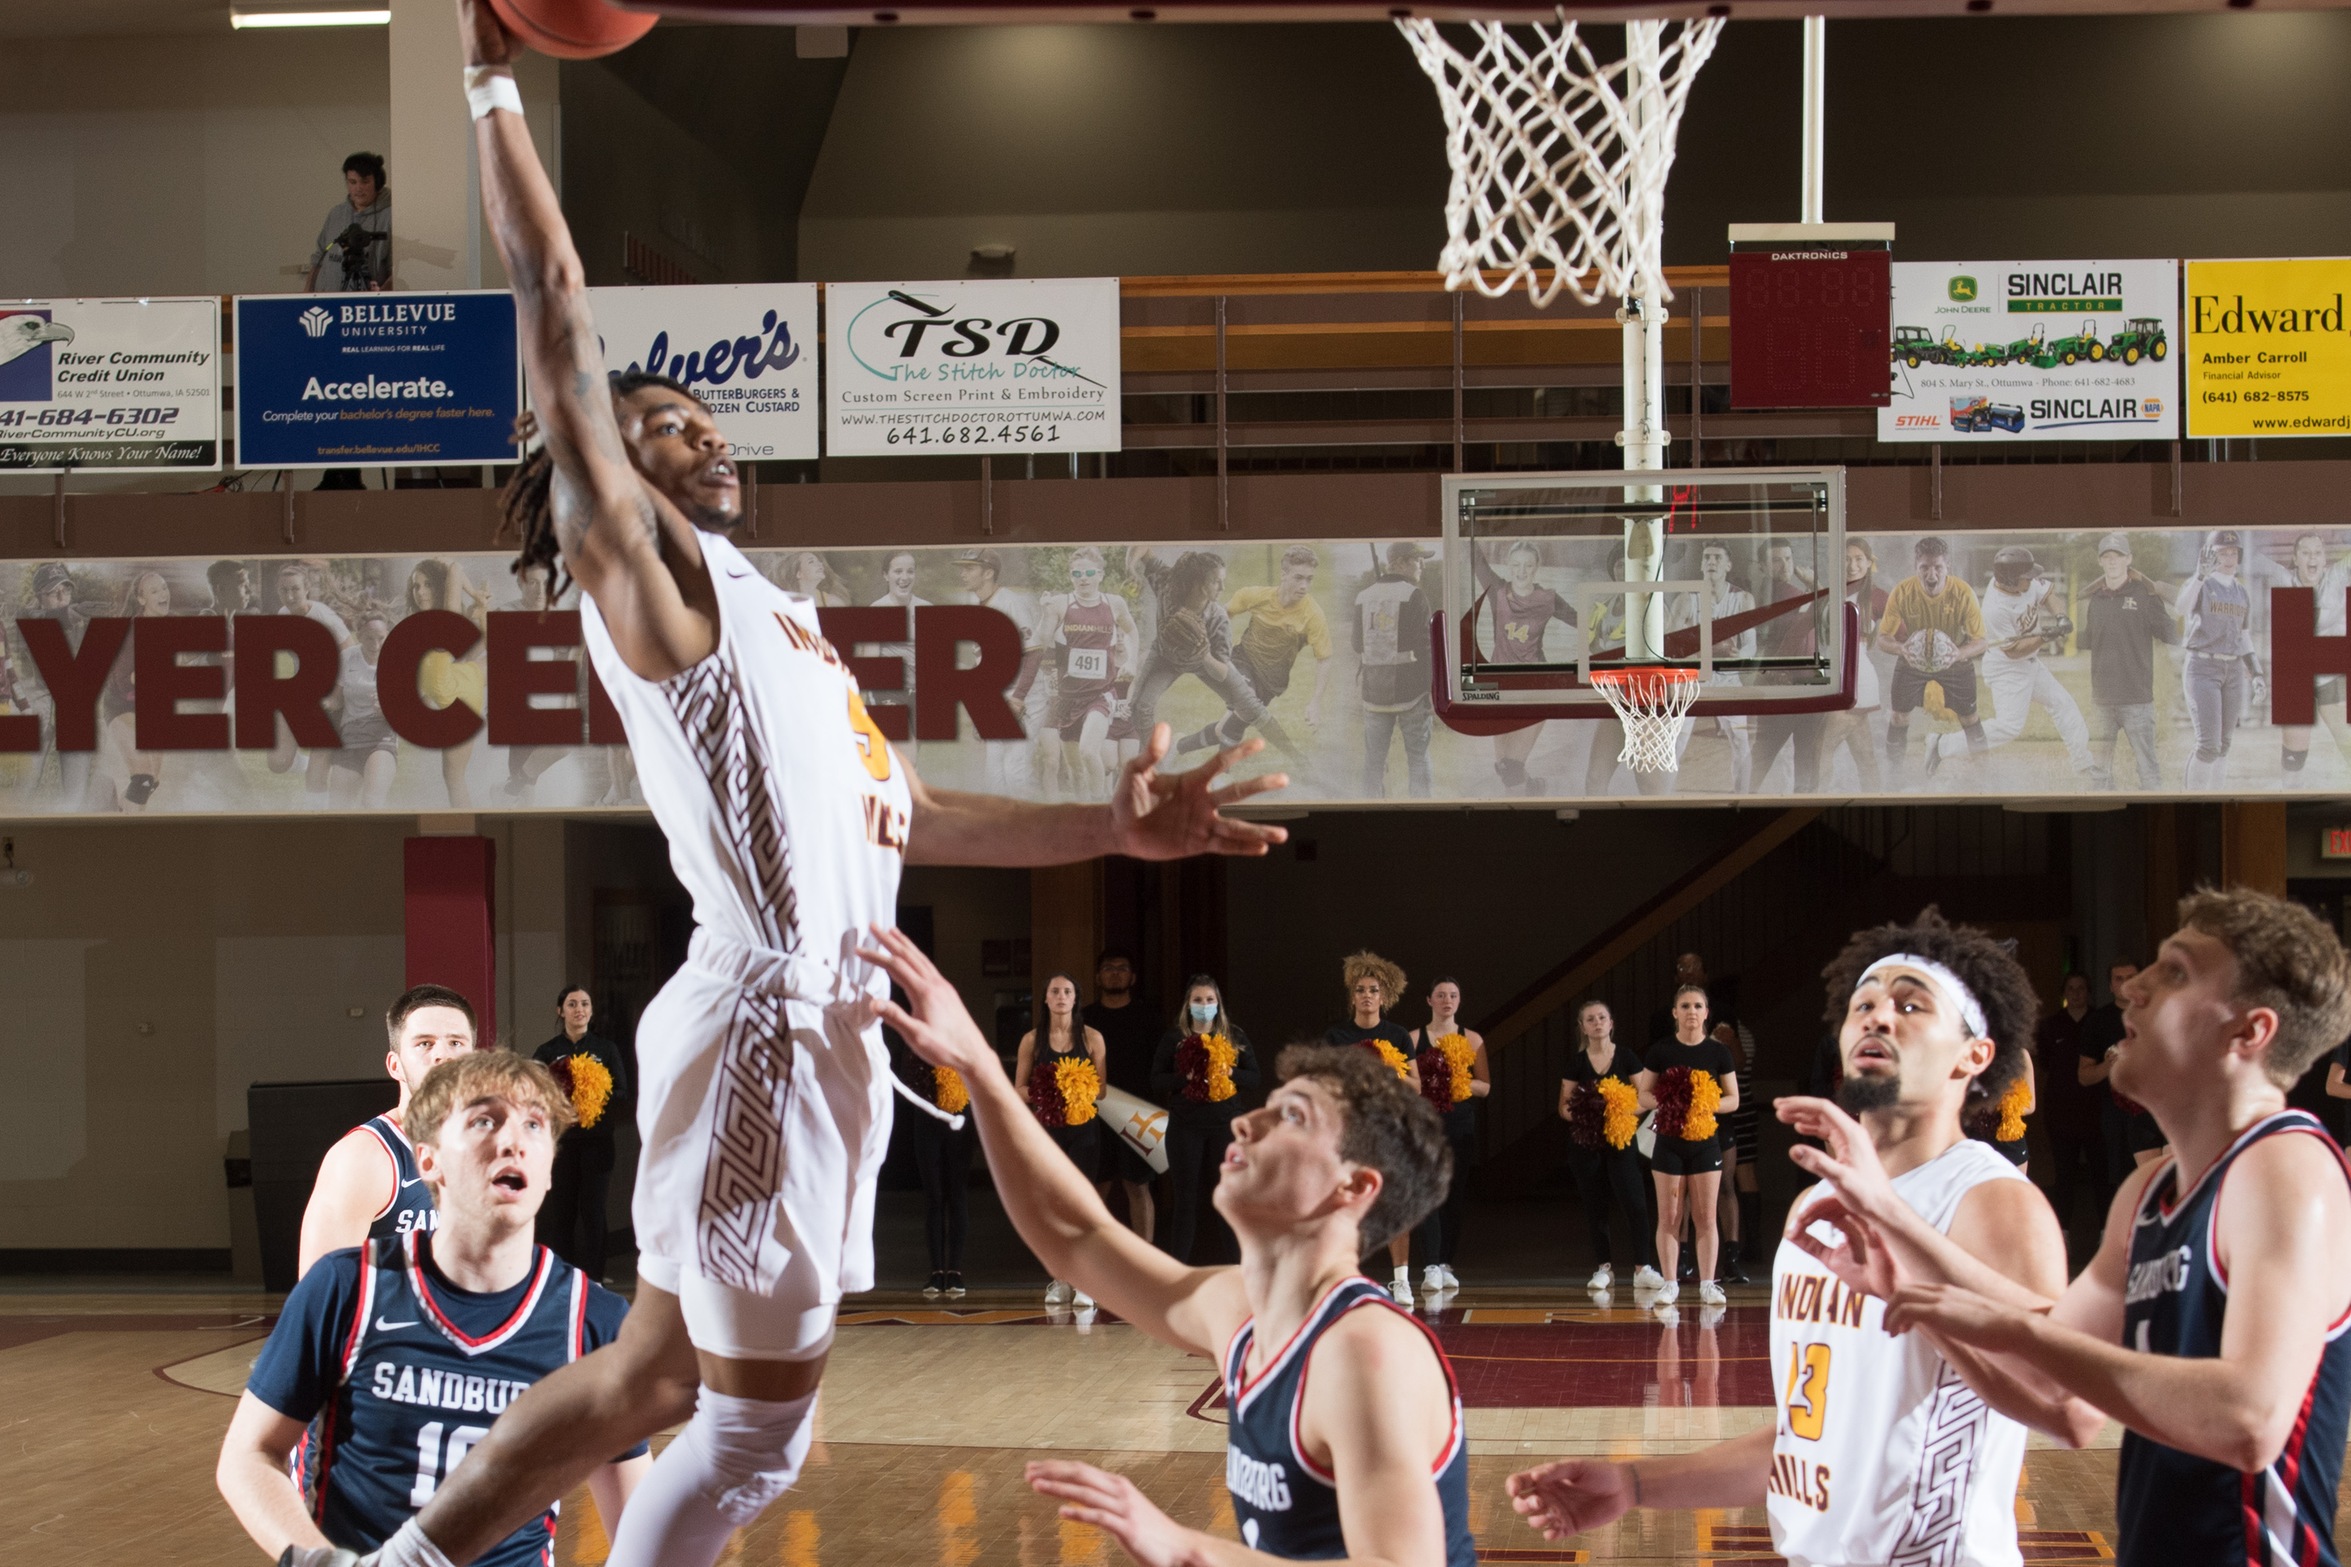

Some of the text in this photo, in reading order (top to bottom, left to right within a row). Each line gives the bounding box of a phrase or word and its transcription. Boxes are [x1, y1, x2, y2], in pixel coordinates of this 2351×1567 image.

[1771, 251, 1848, 261] DAKTRONICS
[2007, 273, 2122, 296] SINCLAIR
[340, 303, 456, 324] BELLEVUE
[1934, 306, 1991, 314] JOHN DEERE
[2026, 301, 2106, 311] TRACTOR
[2191, 293, 2346, 334] Edward
[341, 326, 428, 337] UNIVERSITY
[884, 317, 1060, 358] TSD
[598, 309, 800, 389] lver's
[58, 351, 210, 366] River Community
[2202, 351, 2307, 364] Amber Carroll
[58, 370, 165, 382] Credit Union
[890, 361, 1082, 382] The Stitch Doctor
[2203, 371, 2281, 380] Financial Advisor
[301, 374, 454, 401] Accelerate.
[1921, 379, 1938, 388] 804
[1939, 378, 1947, 388] S.
[1950, 379, 1974, 391] Mary
[1991, 378, 2033, 388] Ottumwa
[2042, 377, 2073, 387] Phone:
[2074, 377, 2136, 387] 641-682-4683
[57, 389, 210, 398] 644 W 2nd Street Ottumwa, IA 52501
[791, 388, 800, 399] &
[842, 386, 1104, 403] Custom Screen Print & Embroidery
[2202, 390, 2310, 404] (641) 682-8575
[709, 401, 800, 413] OZEN CUSTARD
[2030, 398, 2137, 419] SINCLAIR
[2143, 402, 2161, 413] NAPA
[262, 407, 496, 425] Complete your bachelor's degree faster here.
[841, 410, 1106, 426] WWW.THESTITCHDOCTOROTTUMWA.COM
[1895, 415, 1941, 426] STIHL
[2253, 415, 2351, 430] www.edwardj
[886, 424, 1061, 445] 641.682.4561
[0, 442, 203, 468] Everyone Knows Your Name!
[317, 443, 441, 455] transfer.bellevue.edu/IHCC
[1504, 622, 1530, 643] 14
[1074, 655, 1100, 671] 491
[376, 604, 1027, 750] CEER
[1462, 691, 1500, 702] SPALDING
[847, 687, 891, 782] 5
[1777, 1272, 1866, 1329] INDIAN
[1784, 1342, 1832, 1442] 13
